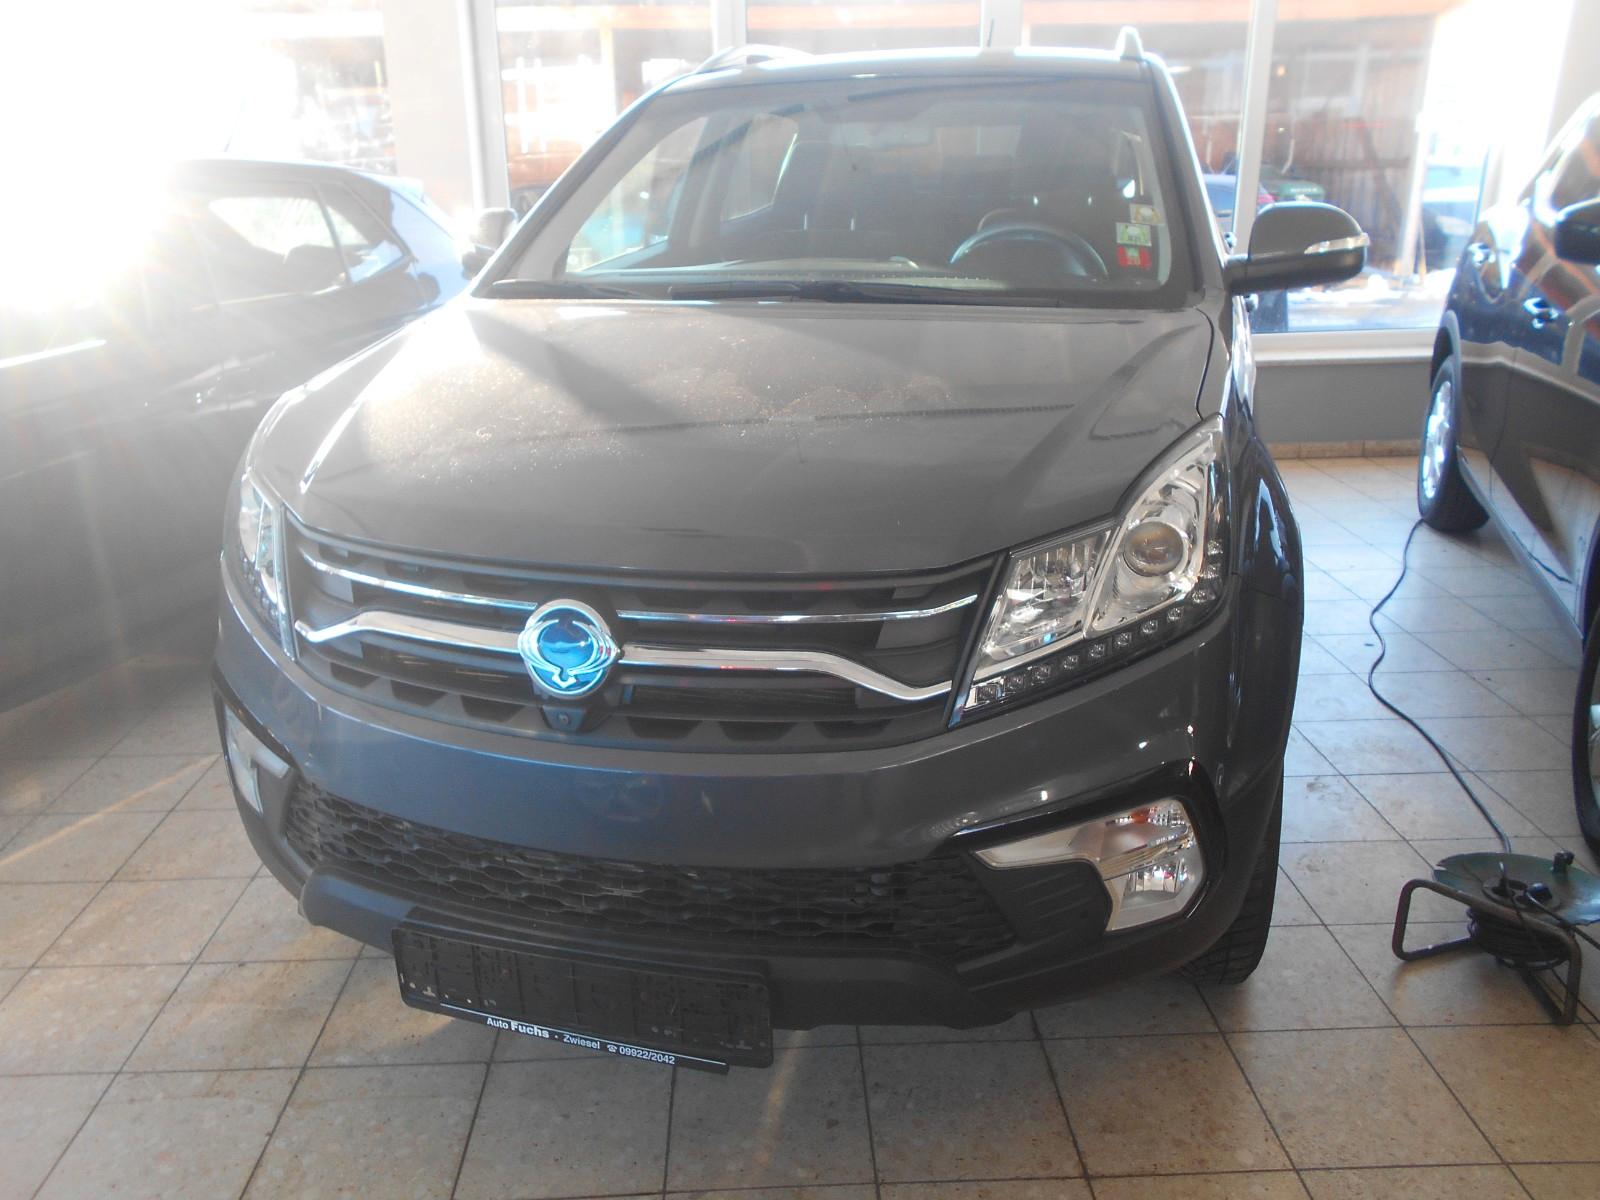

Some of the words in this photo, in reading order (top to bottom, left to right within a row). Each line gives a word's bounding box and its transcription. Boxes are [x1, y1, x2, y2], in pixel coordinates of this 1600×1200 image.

[486, 1017, 509, 1030] Auto
[510, 1021, 550, 1038] Fuchs
[563, 1034, 600, 1050] Zwiesel
[619, 1046, 676, 1065] 09922/2042
